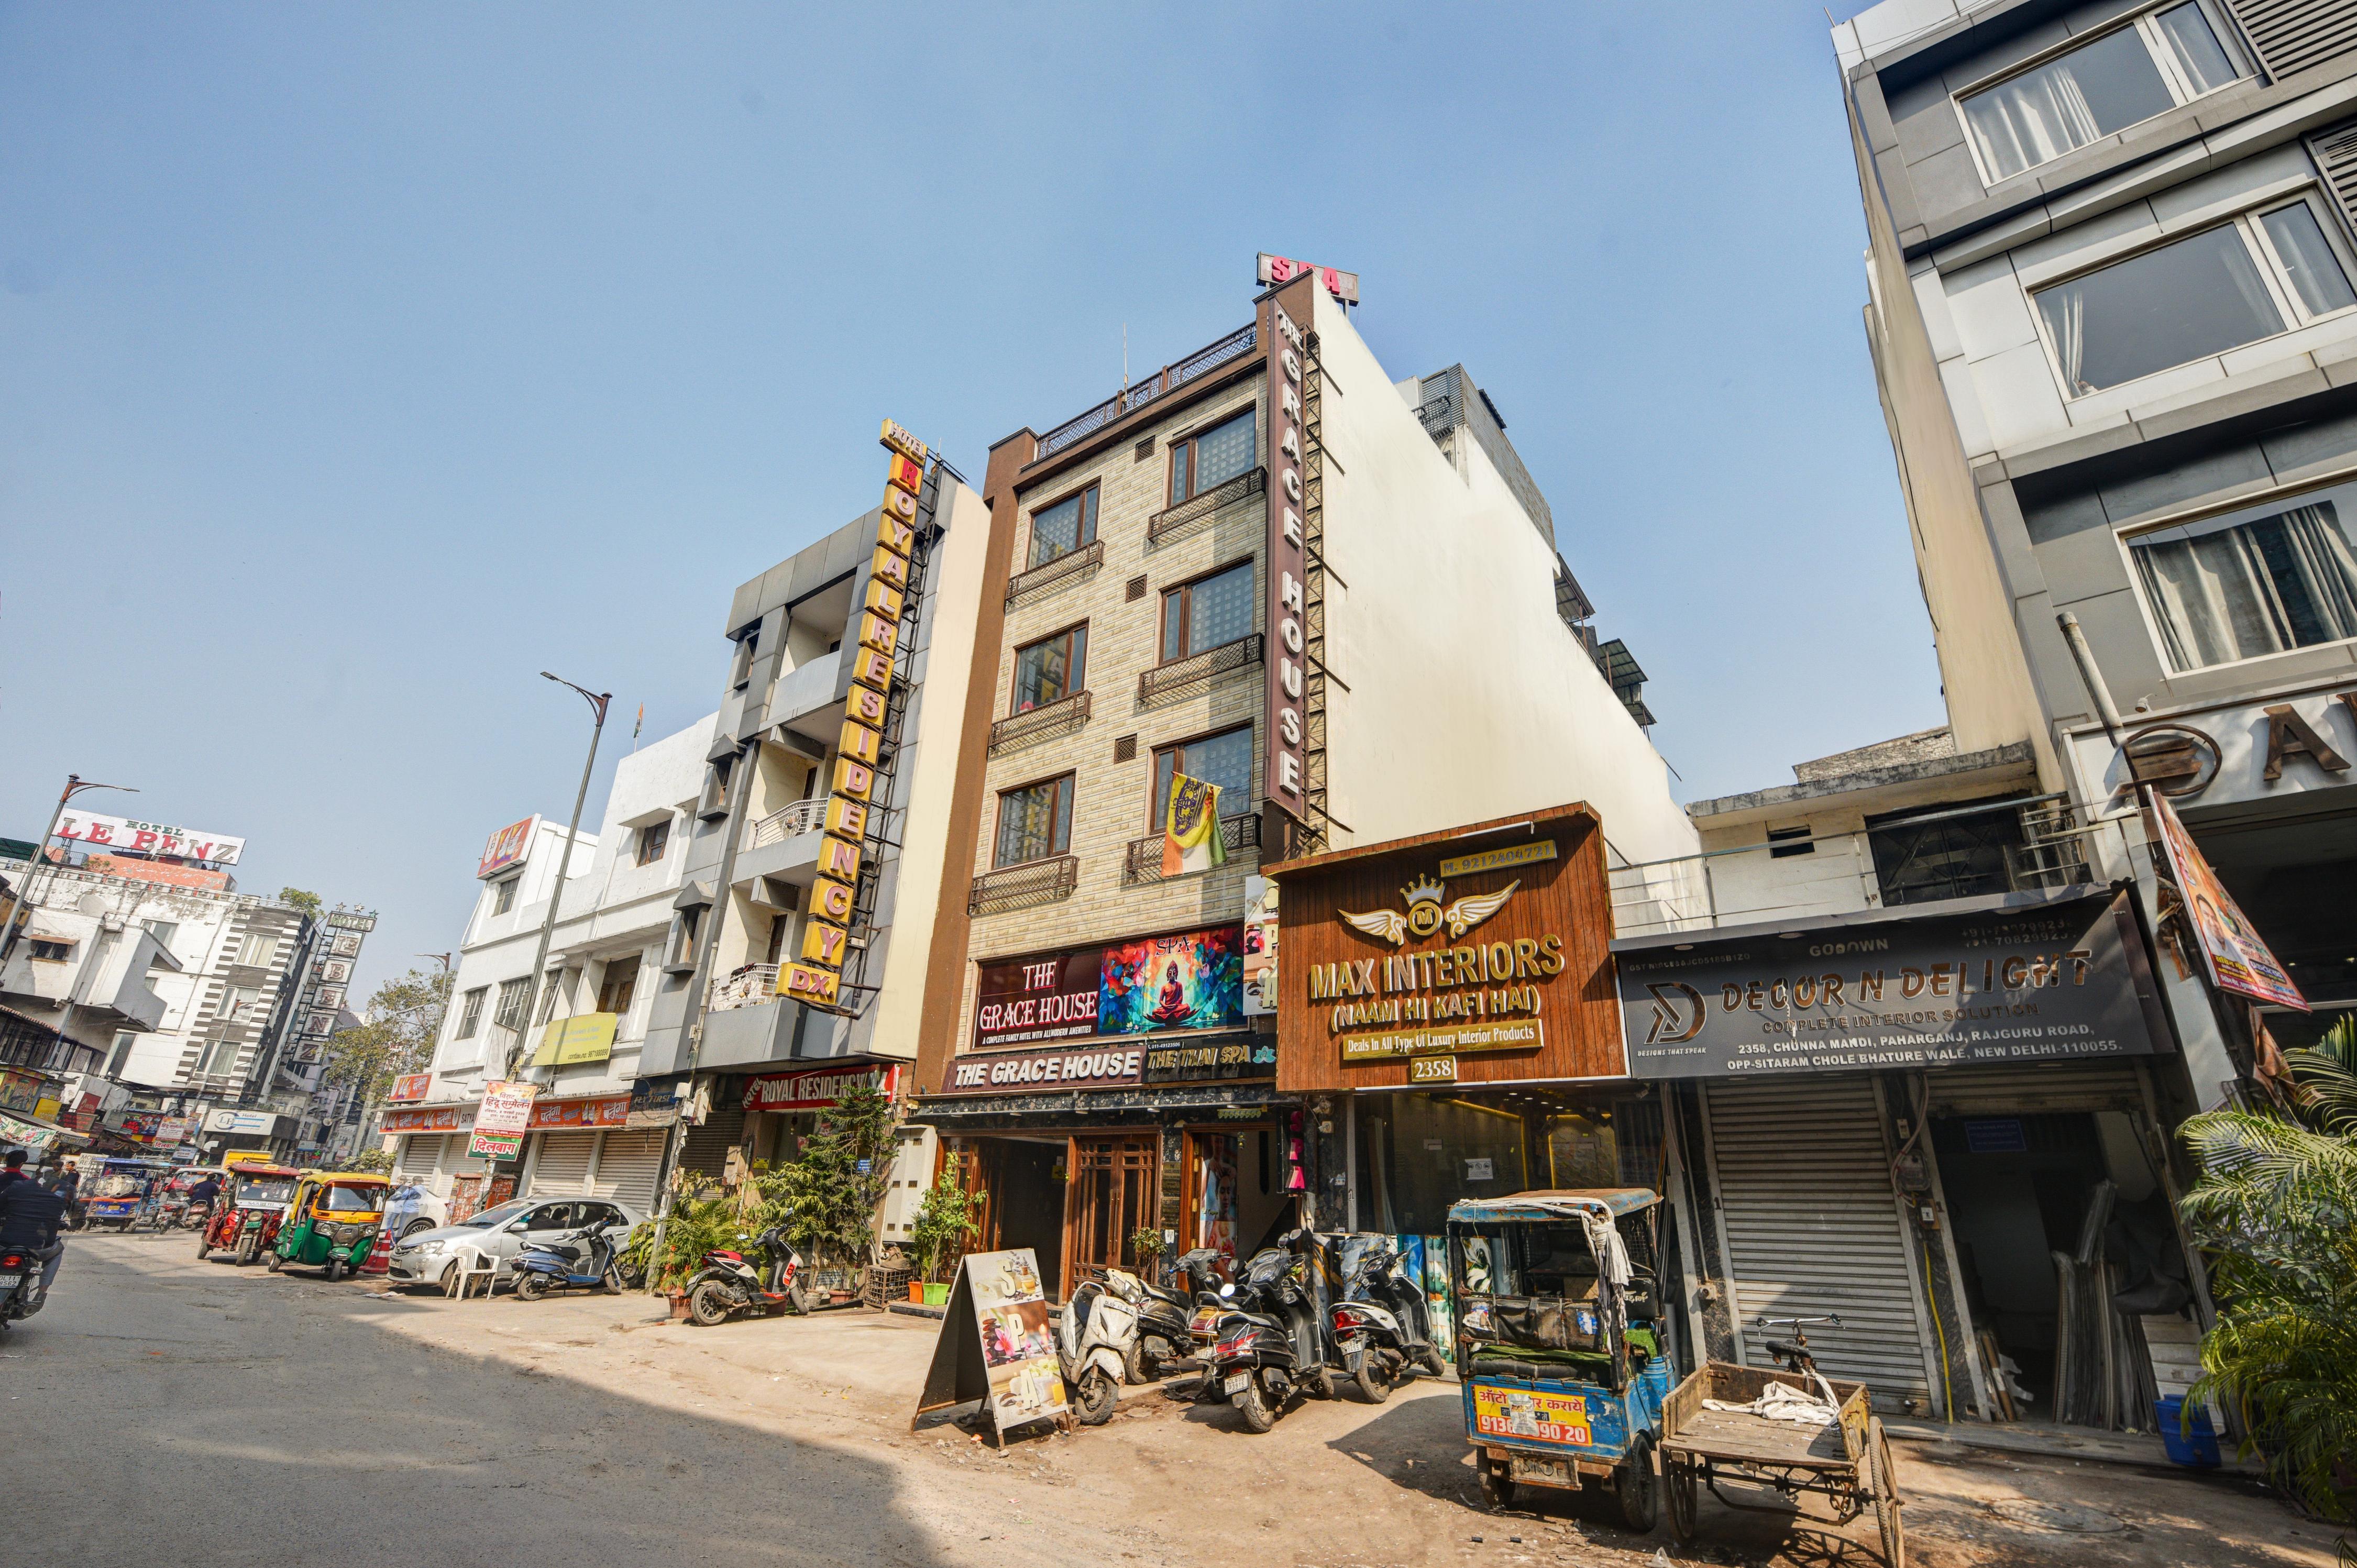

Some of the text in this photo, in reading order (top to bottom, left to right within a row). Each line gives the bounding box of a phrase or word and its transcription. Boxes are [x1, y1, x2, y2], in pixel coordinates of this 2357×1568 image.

[888, 422, 927, 460] HOTEL
[1278, 309, 1303, 794] THE GRACE HOUSE
[821, 458, 918, 959] ROYAL RESIDENCY
[57, 817, 115, 844] LE
[125, 820, 183, 836] HOTEL
[331, 915, 373, 931] HOTEL
[1415, 909, 1434, 925] M
[1155, 935, 1191, 957] SPA
[1023, 962, 1057, 991] THE
[1310, 934, 1566, 999] MAX INTERIORS
[1721, 949, 2092, 1013] DECOR N DELIGHT
[300, 935, 359, 1060] LE BENZ
[980, 991, 1099, 1032] GRACE HOUSE
[1331, 984, 1541, 1032] (NAAM HI KAFI HAI)
[1762, 1002, 2040, 1033] COMPLETE INTERIOR SOLUTION
[986, 1035, 1005, 1043] COMPLETE
[1006, 1033, 1019, 1042] FAMILY
[1019, 1032, 1031, 1041] HOTEL
[1032, 1031, 1043, 1039] WITH
[1069, 1025, 1092, 1035] AMENITIES
[1348, 1025, 1535, 1053] Deals In All Type Of Luxury Interior Products
[1738, 1024, 2095, 1055] 2358, CHUNNA MANDI, PAHARGANJ, RAJGURU ROAD,
[955, 1051, 1141, 1087] THE GRACE HOUSE
[1148, 1045, 1251, 1069] THE THAI SPA
[1415, 1060, 1451, 1078] 2358
[1727, 1040, 2123, 1070] OPP-SITARAM CHOLE BHATURE WALE, NEW DELHI-110055.
[486, 1096, 531, 1109] हिंदू सम्मेलन
[742, 1077, 764, 1109] HOTEL
[761, 1079, 797, 1103] ROYAL
[219, 1116, 234, 1125] LE
[461, 1113, 475, 1123] SATYA
[474, 1137, 516, 1154] दिलबाग
[1285, 1110, 1306, 1189] SPA
[999, 1258, 1041, 1410] SPA
[1479, 1388, 1507, 1404] ऑटो
[1546, 1398, 1583, 1412] कराये
[1565, 1426, 1585, 1443] 20
